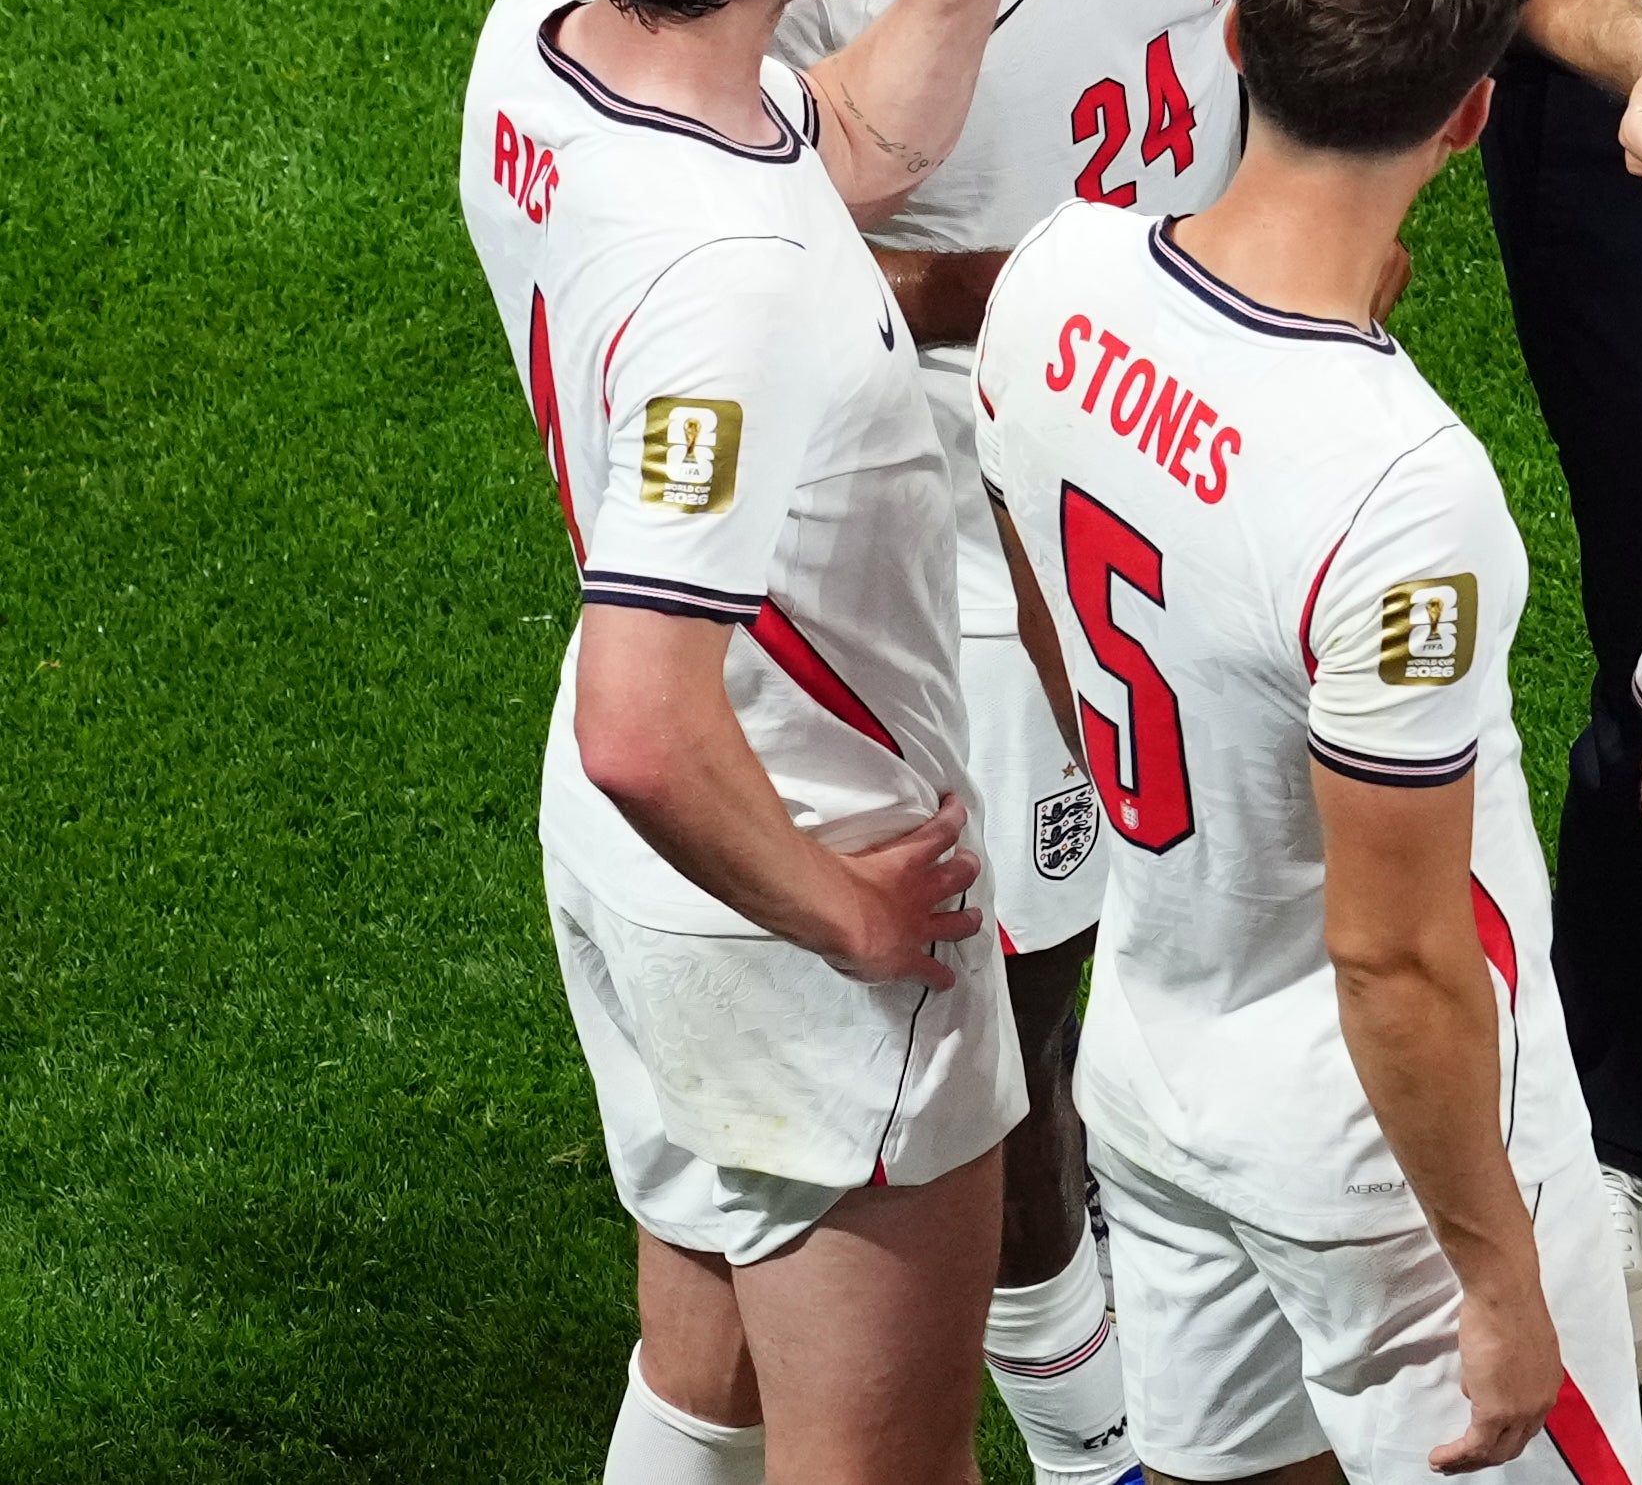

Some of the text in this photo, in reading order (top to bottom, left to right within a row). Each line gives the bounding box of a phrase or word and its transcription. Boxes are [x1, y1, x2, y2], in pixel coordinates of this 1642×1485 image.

[1071, 30, 1196, 208] 24
[1046, 314, 1241, 504] STONES
[663, 491, 709, 506] 2026
[1060, 479, 1195, 855] 5
[1404, 666, 1455, 678] 2026
